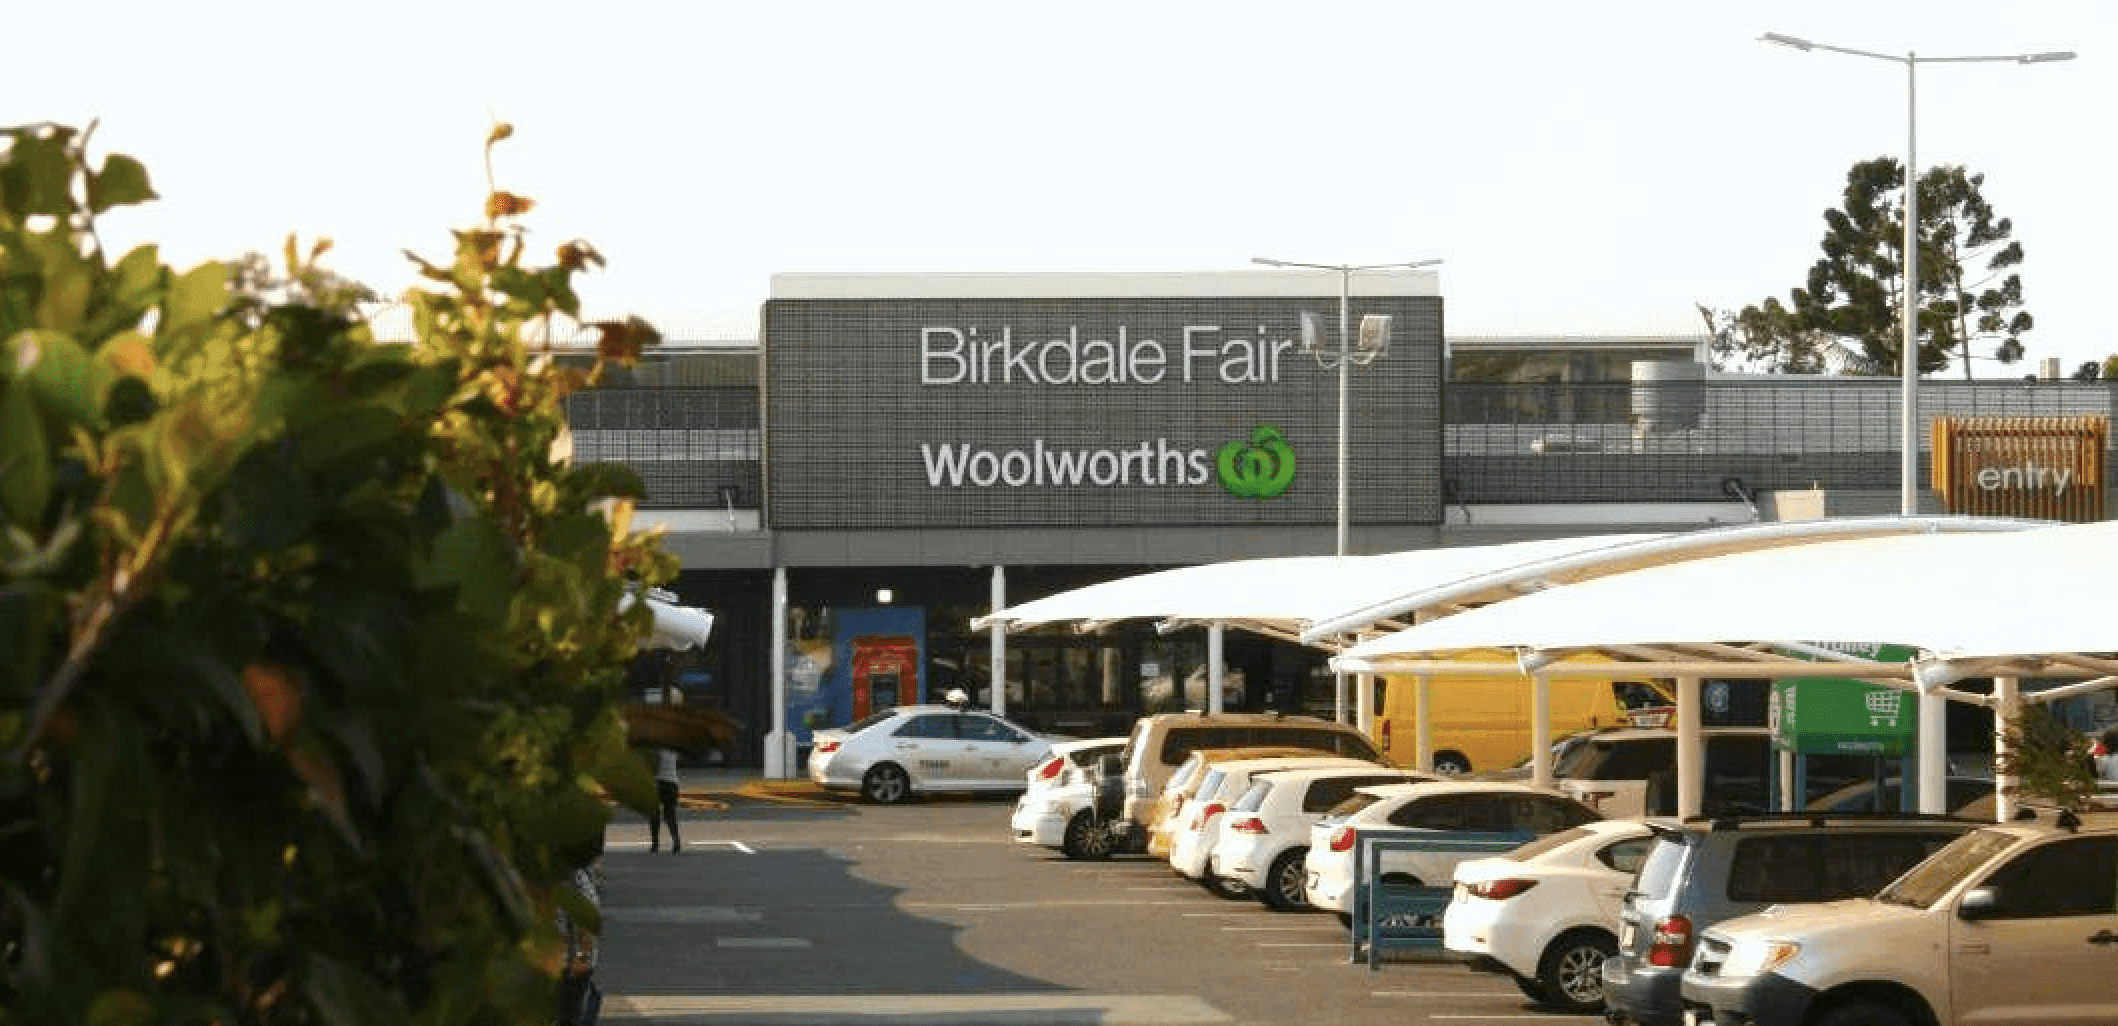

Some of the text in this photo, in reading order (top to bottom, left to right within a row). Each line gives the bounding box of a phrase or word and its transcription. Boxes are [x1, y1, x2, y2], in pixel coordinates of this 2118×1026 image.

[921, 325, 1292, 385] Birkdale Fair
[921, 437, 1209, 487] Woolworths
[1977, 461, 2072, 497] entry
